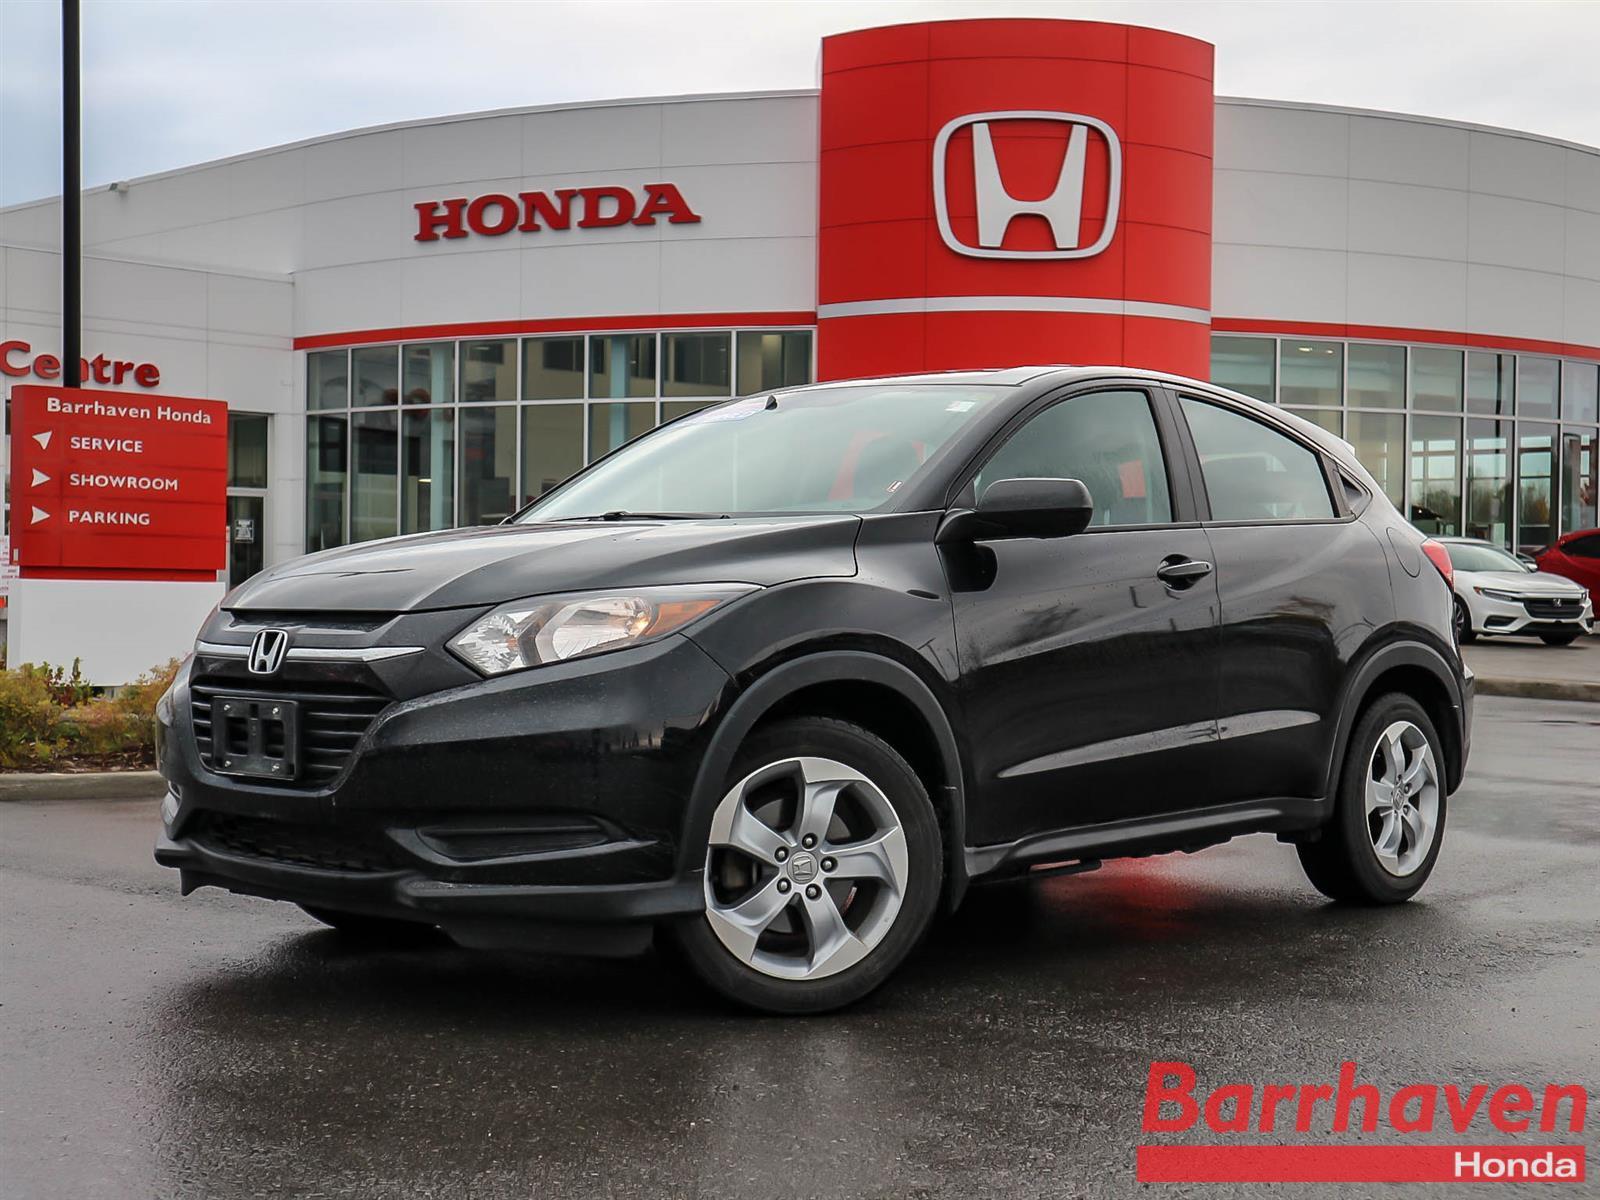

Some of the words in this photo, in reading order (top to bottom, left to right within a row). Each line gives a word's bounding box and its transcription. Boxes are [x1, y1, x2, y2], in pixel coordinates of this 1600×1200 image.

[413, 183, 702, 241] HONDA
[47, 397, 150, 419] Barrhaven
[157, 406, 212, 425] Honda
[70, 436, 143, 453] SERVICE
[69, 474, 178, 491] SHOWROOM
[68, 510, 150, 526] PARKING
